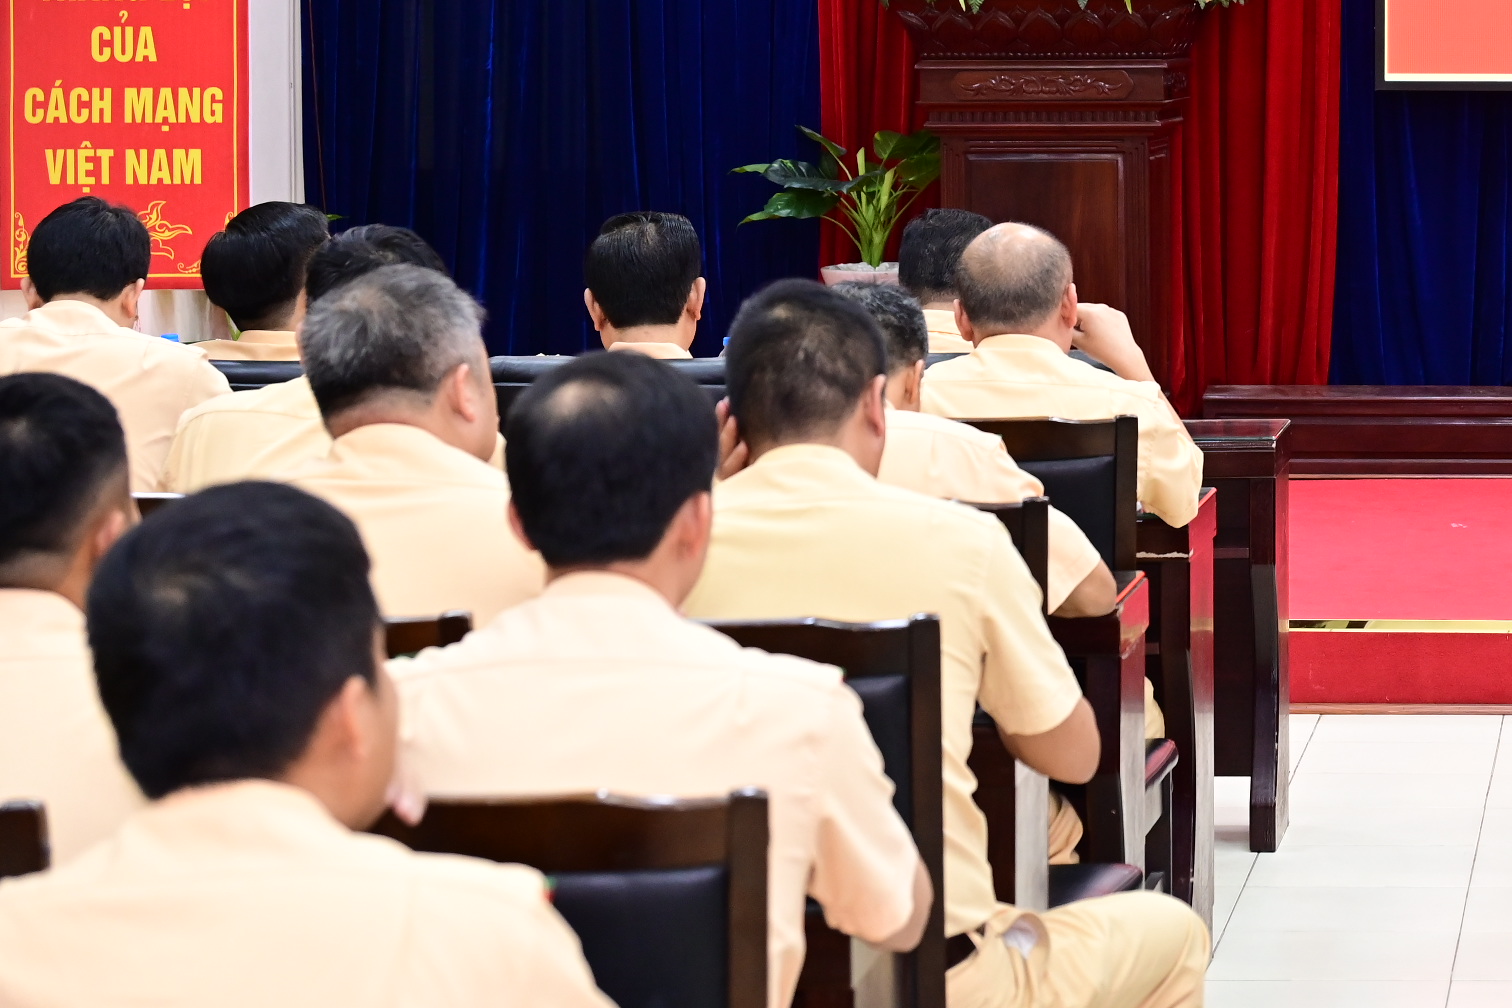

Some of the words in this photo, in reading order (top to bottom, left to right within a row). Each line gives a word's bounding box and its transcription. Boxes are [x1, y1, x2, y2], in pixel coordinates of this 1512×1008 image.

[91, 10, 157, 62] CỦA
[25, 80, 111, 124] CÁCH
[125, 87, 223, 131] MẠNG
[45, 141, 114, 193] VIỆT
[126, 149, 201, 184] NAM
